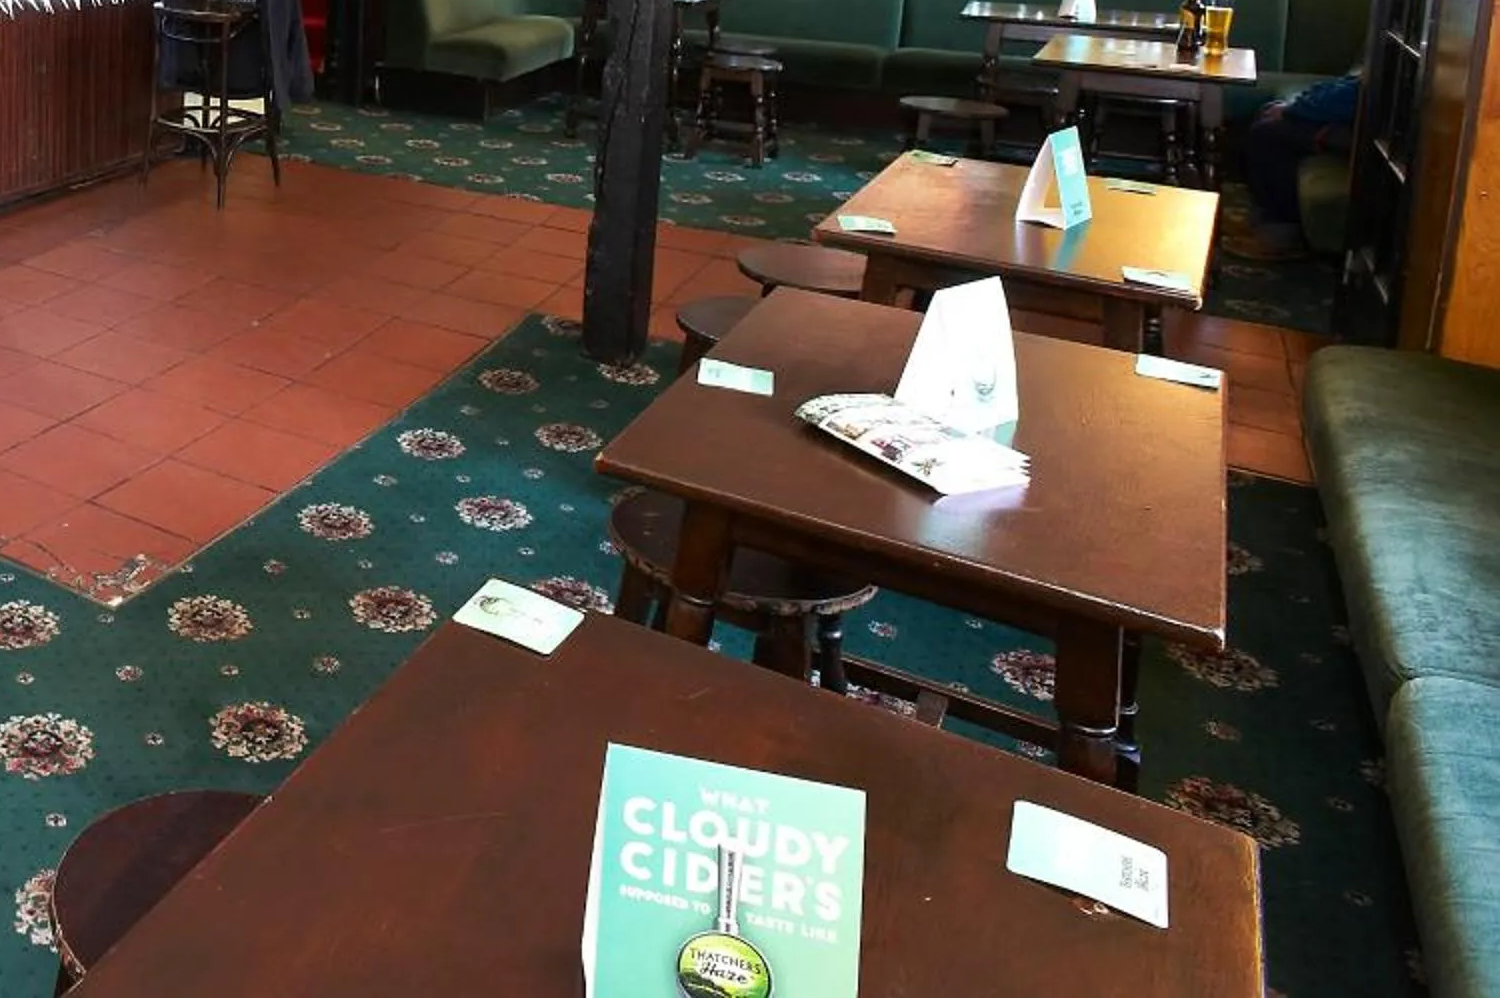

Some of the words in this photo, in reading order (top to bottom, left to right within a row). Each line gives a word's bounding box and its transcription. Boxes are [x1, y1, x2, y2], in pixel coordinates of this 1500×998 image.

[700, 787, 770, 814] WHAT
[623, 797, 850, 874] CLOUDY
[620, 842, 841, 921] CIDER'S
[619, 884, 689, 910] SUPPOSED
[691, 900, 710, 915] TO
[745, 912, 794, 935] TASTE
[801, 927, 838, 943] LIKE
[690, 947, 761, 975] THATCHERS
[699, 960, 749, 985] Haze
